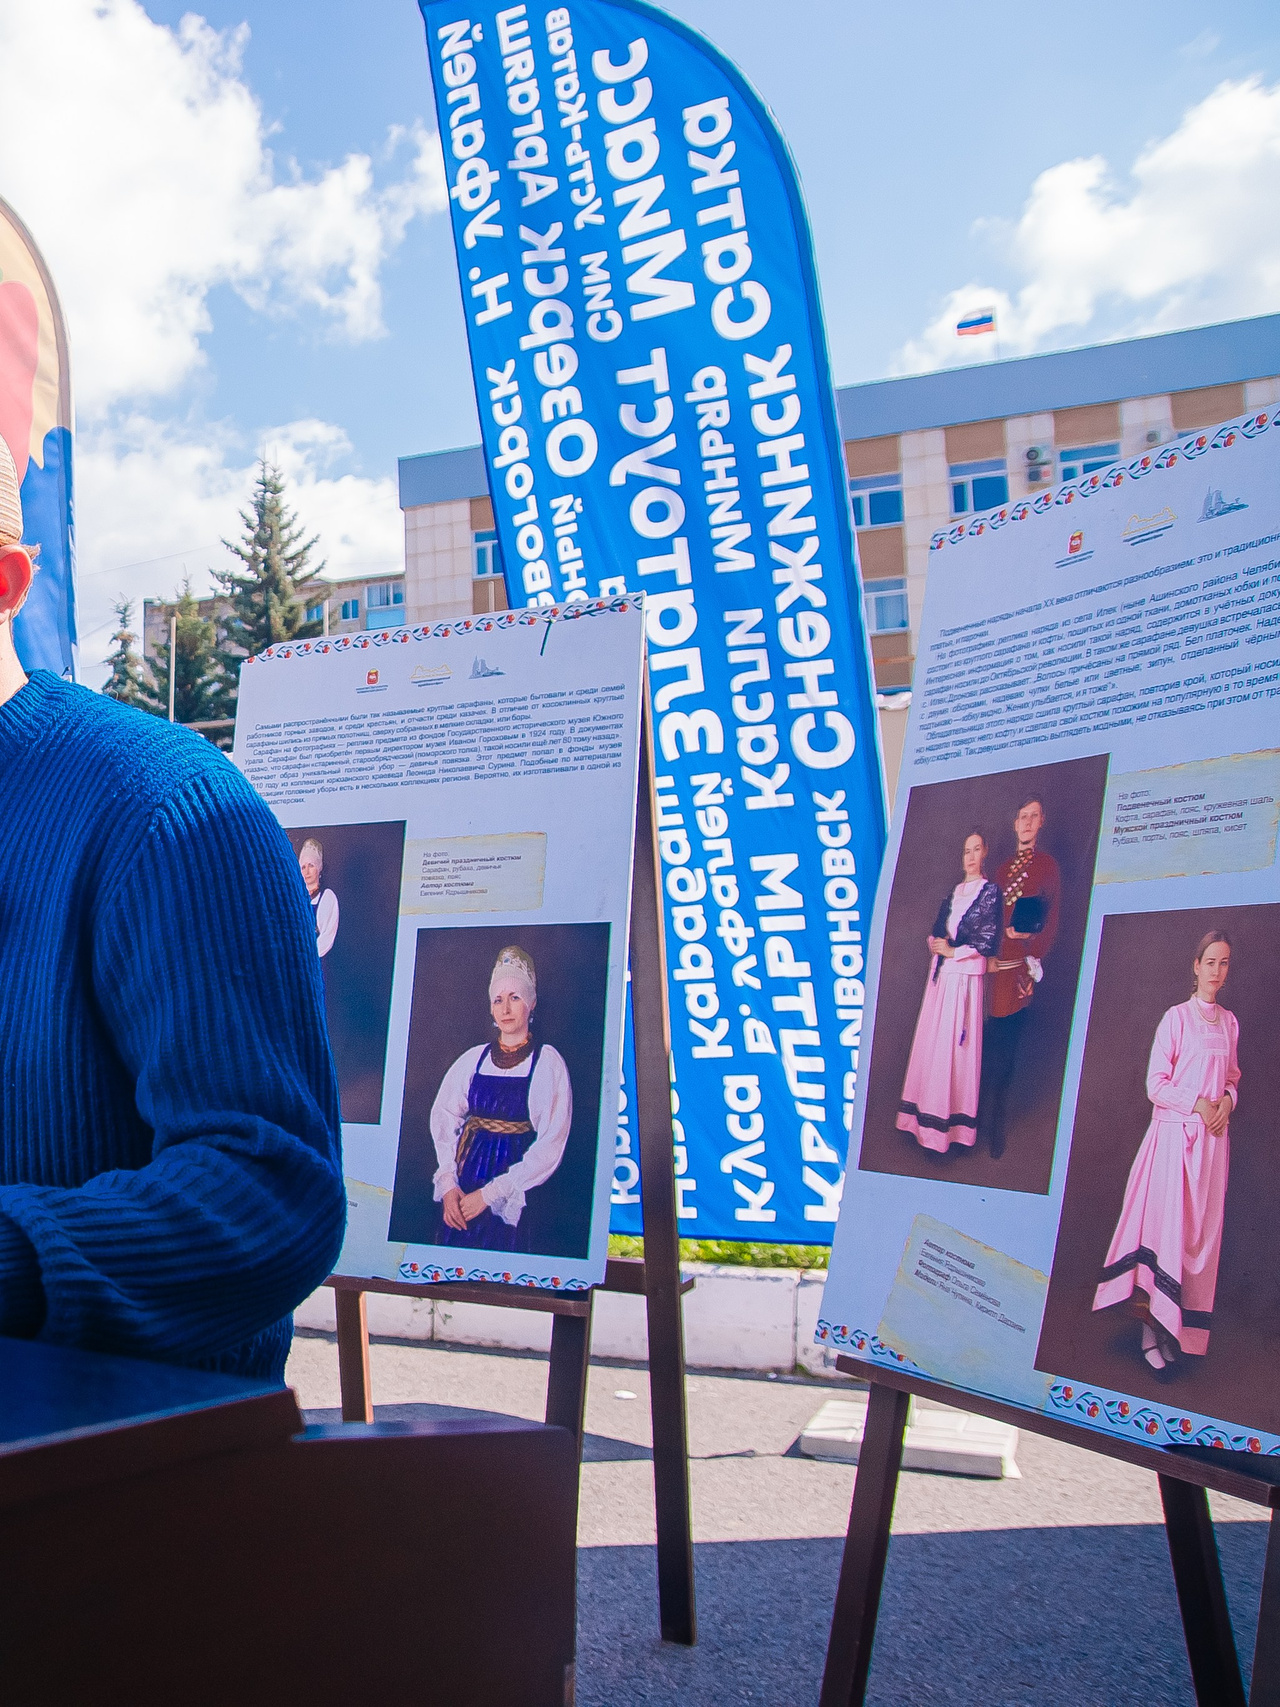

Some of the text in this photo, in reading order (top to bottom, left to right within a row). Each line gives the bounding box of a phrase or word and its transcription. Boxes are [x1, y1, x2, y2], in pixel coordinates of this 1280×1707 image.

[1073, 613, 1092, 623] села
[1096, 604, 1117, 617] Илек
[1120, 596, 1145, 613] (ныне
[1149, 581, 1198, 603] Ашинского
[1202, 570, 1237, 590] района
[1089, 631, 1111, 644] такой
[1115, 625, 1142, 640] наряд,
[1146, 610, 1200, 631] содержится
[1213, 594, 1254, 614] учётных
[1054, 639, 1239, 689] белые или цветные; зипун, отделанный
[1068, 656, 1112, 676] причёсаны
[1128, 644, 1160, 662] прямой
[1163, 641, 1181, 653] ряд.
[1184, 634, 1202, 646] Бел
[1205, 623, 1251, 641] платочек.
[1080, 709, 1110, 721] костюм
[1112, 701, 1148, 715] похожим
[1164, 686, 1221, 706] популярную
[1246, 673, 1278, 689] время
[1096, 663, 1250, 707] сарафан, повторив крой, который
[1150, 816, 1207, 831] праздничный
[1209, 812, 1243, 823] костюм
[1173, 793, 1206, 804] костюм
[1223, 823, 1248, 833] кисет
